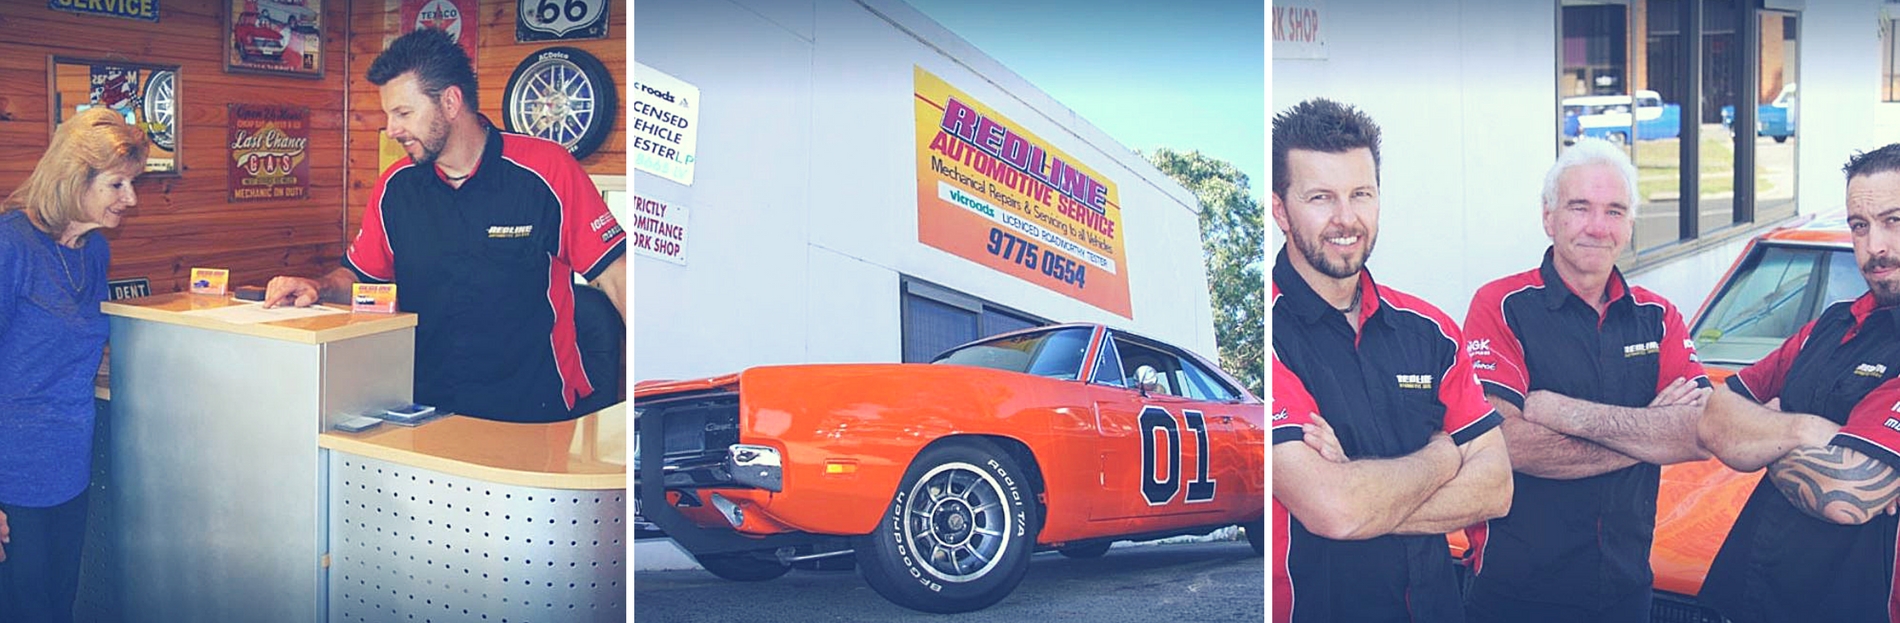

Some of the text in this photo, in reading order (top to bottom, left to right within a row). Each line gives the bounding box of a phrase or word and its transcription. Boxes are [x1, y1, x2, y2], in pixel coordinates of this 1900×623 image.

[537, 0, 588, 24] 66
[1289, 6, 1319, 42] SHOP
[641, 84, 675, 103] roads
[232, 130, 307, 149] Last Chance
[634, 117, 682, 144] EHICLE
[634, 135, 674, 160] ESTER
[940, 96, 1107, 216] REDLINE
[235, 188, 272, 198] MECHANIC
[286, 186, 303, 196] DUTY
[929, 130, 1115, 239] AUTOMOTIVE SERVICE
[931, 155, 1113, 254] Mechanical Repairs & Servicing to all Vehicles
[654, 238, 680, 257] SHOP
[950, 189, 994, 218] vicroads
[1002, 212, 1040, 237] LICENCED
[1087, 251, 1108, 267] TESTER
[986, 227, 1086, 289] 9775 0554
[1138, 405, 1217, 506] 01
[987, 459, 1026, 537] Radial T/A
[892, 491, 943, 593] BFGoodrich
